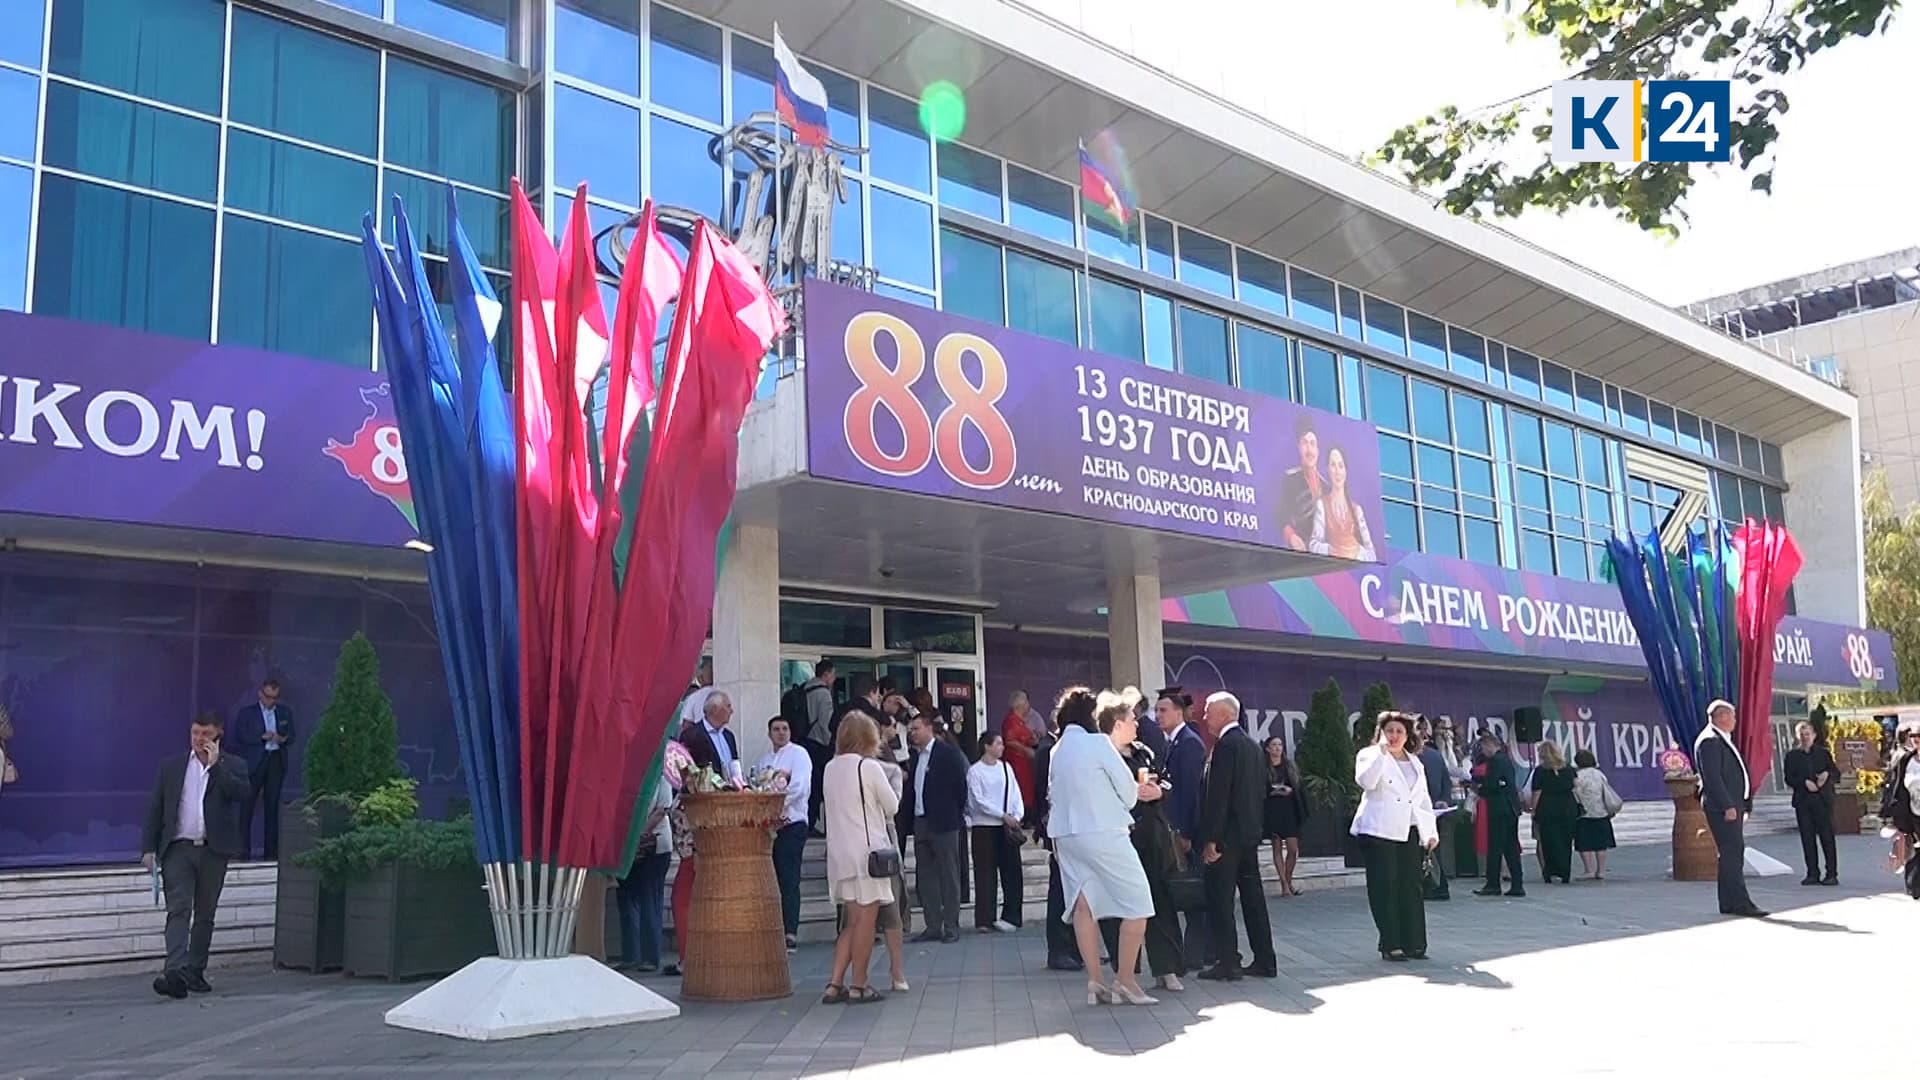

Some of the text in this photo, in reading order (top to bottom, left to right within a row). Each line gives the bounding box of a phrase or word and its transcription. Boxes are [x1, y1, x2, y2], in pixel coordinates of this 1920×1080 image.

[0, 375, 266, 471] КОМ!
[843, 311, 1017, 490] 88
[1074, 364, 1250, 434] 13 СЕНТЯБРЯ
[1077, 405, 1253, 475] 1937 ГОДА
[1015, 474, 1063, 494] лет
[1081, 455, 1256, 505] ДЕНЬ ОБРАЗОВАНИЯ
[1083, 486, 1259, 531] КРАСНОДАРСКОГО КРАЯ
[1360, 574, 1384, 619] С
[1400, 581, 1488, 630] ДНЕМ
[1773, 628, 1814, 666] РАЙ!
[1847, 633, 1873, 679] 88
[1611, 723, 1674, 768] КРА
